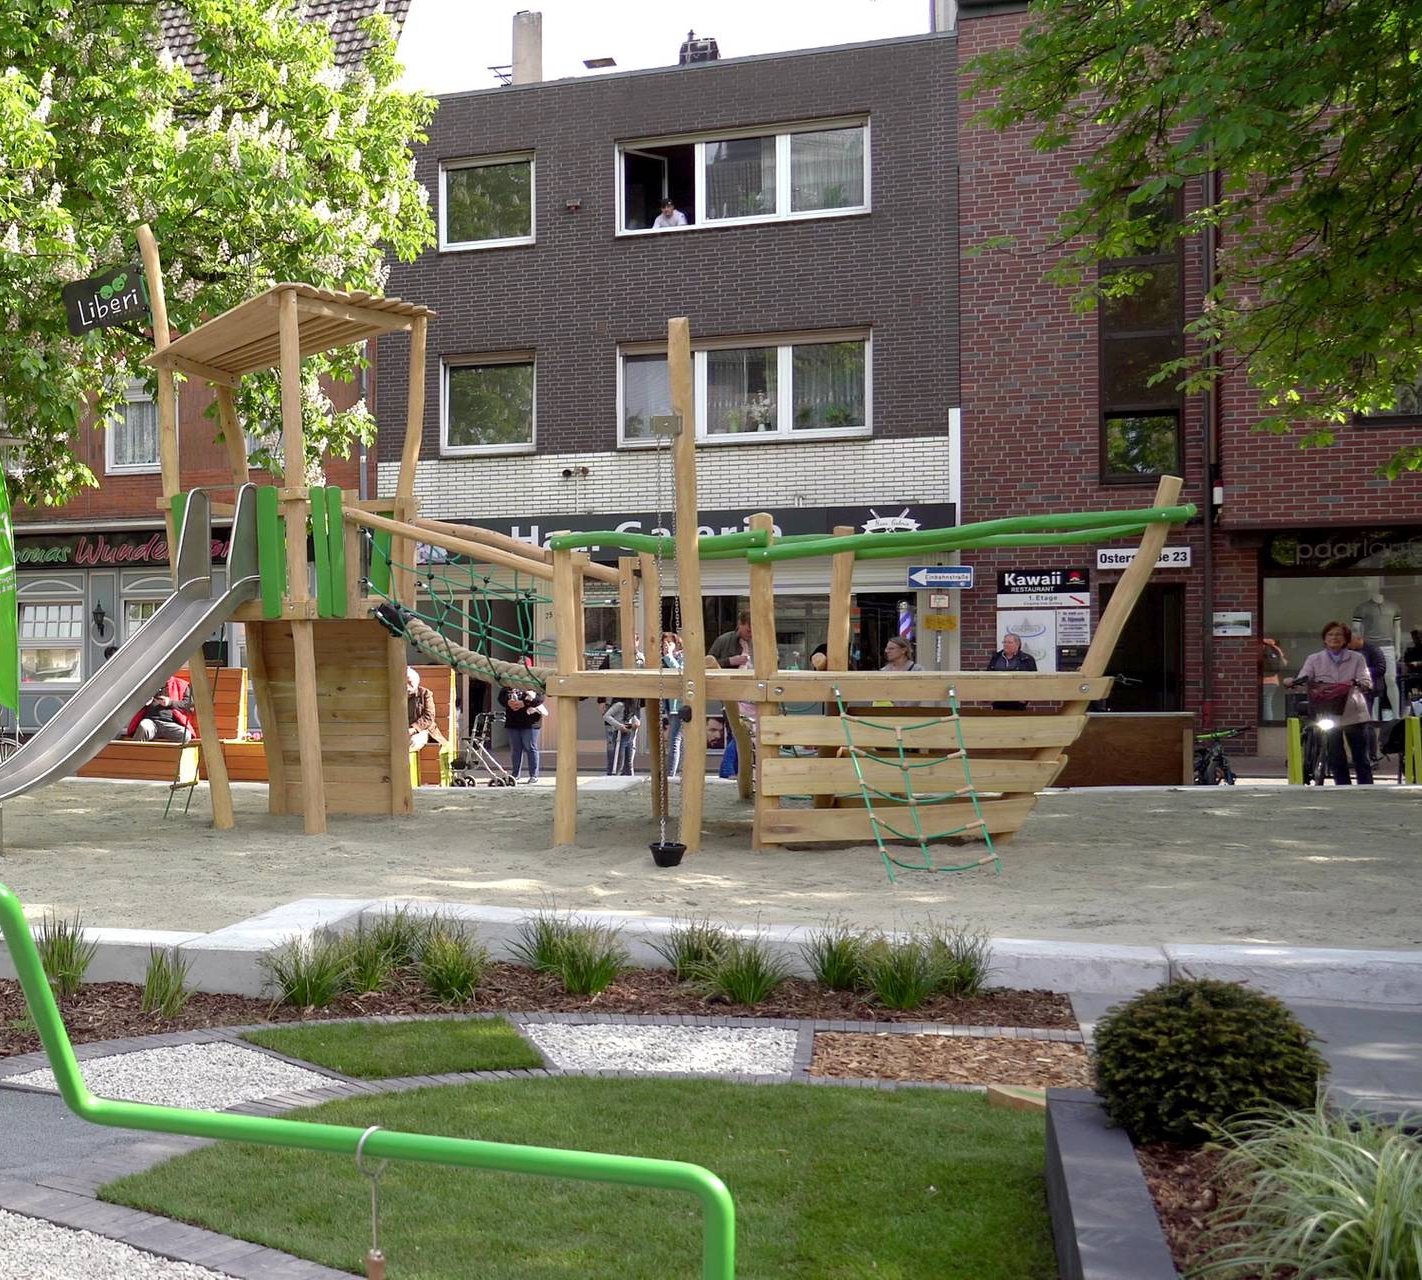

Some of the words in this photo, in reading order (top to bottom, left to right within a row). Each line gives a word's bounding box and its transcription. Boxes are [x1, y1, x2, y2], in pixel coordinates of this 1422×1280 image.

[78, 289, 138, 326] Liberi
[1172, 551, 1188, 562] 23
[1004, 572, 1062, 586] Kawaii
